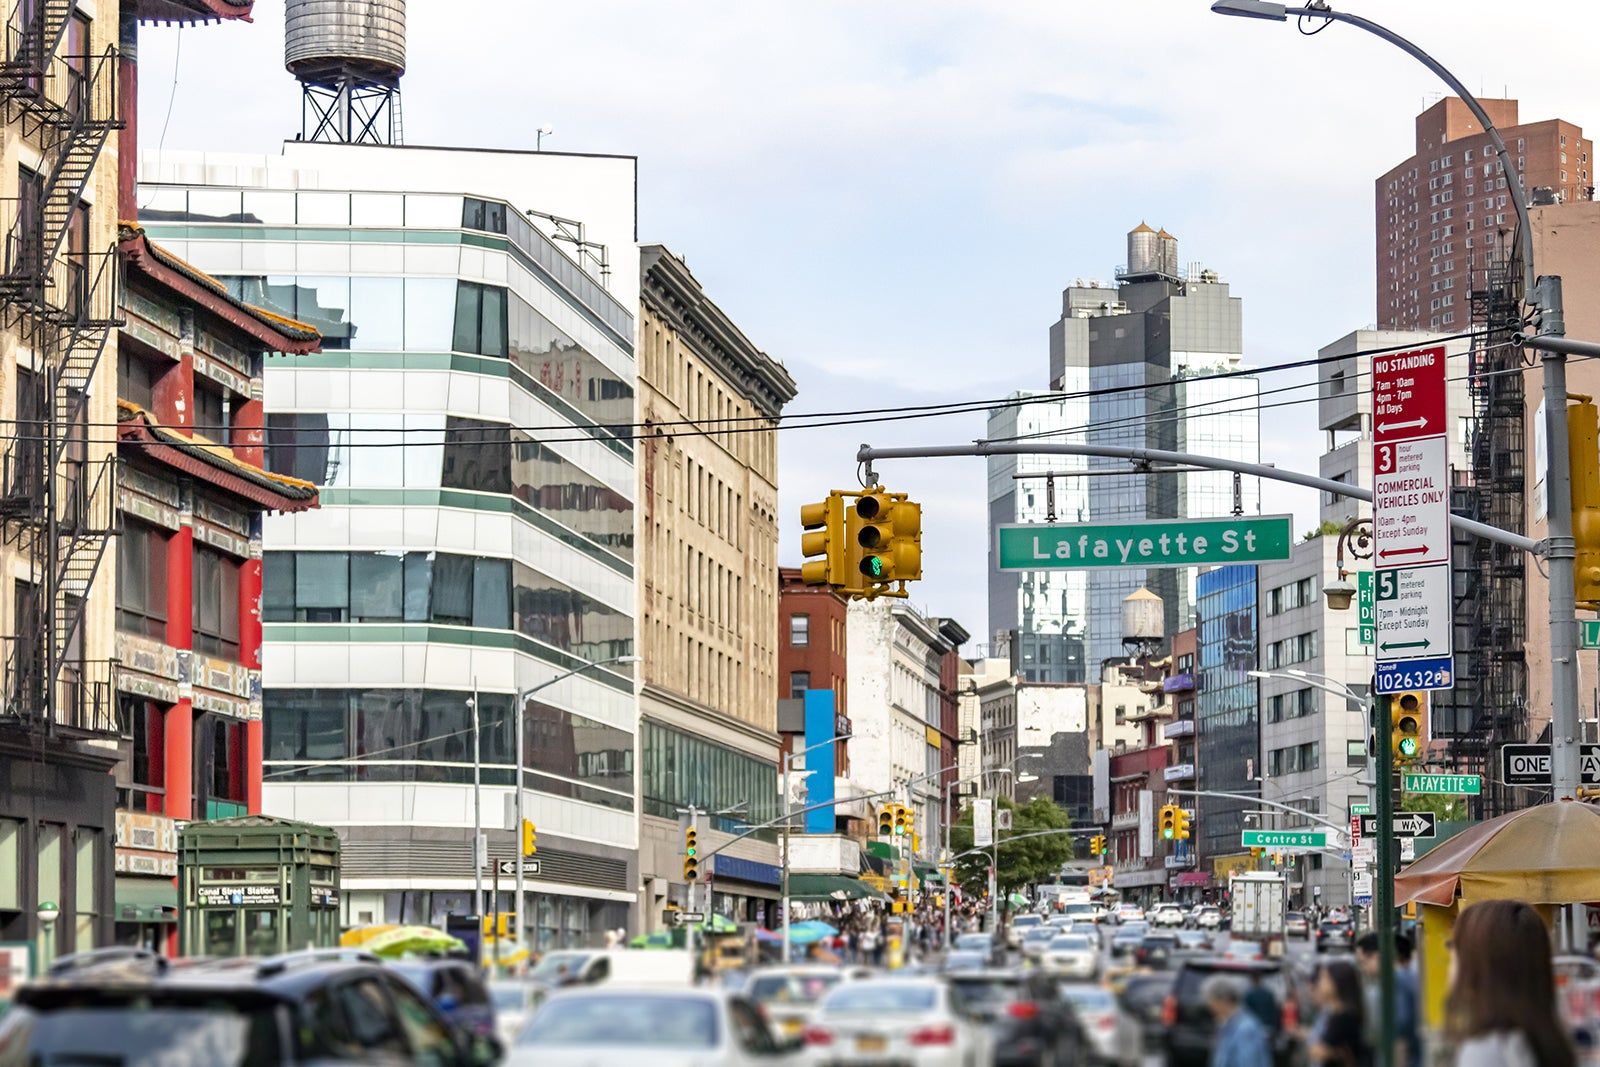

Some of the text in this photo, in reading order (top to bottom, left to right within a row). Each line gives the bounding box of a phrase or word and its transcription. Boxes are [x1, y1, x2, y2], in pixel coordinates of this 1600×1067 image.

[1376, 354, 1435, 374] NO STANDING
[1376, 381, 1390, 390] 7am
[1396, 378, 1414, 388] 10am
[1376, 394, 1392, 404] 4pm
[1397, 390, 1412, 401] 7pm
[1376, 404, 1402, 415] All Days
[1379, 446, 1392, 472] 3
[1399, 452, 1423, 462] metered
[1399, 464, 1420, 473] parking
[1377, 477, 1434, 494] COMMERCIAL
[1378, 491, 1444, 509] VEHICLES ONLY
[1378, 517, 1395, 526] 10am
[1402, 514, 1416, 525] 4pm
[1378, 526, 1428, 539] Except Sunday
[1033, 529, 1257, 562] Lafayette St
[1380, 572, 1394, 598] 5
[1400, 580, 1424, 589] metered
[1400, 592, 1422, 600] parking
[1378, 608, 1394, 619] 7pm
[1400, 606, 1428, 617] Midnight
[1378, 618, 1430, 631] Except Sunday
[1378, 670, 1434, 690] 102632
[1514, 758, 1550, 772] ONE
[1405, 776, 1478, 792] LAFAYETTE ST
[1402, 821, 1424, 830] WAY
[1257, 834, 1313, 844] Centre St
[198, 886, 274, 896] Canal Street Station
